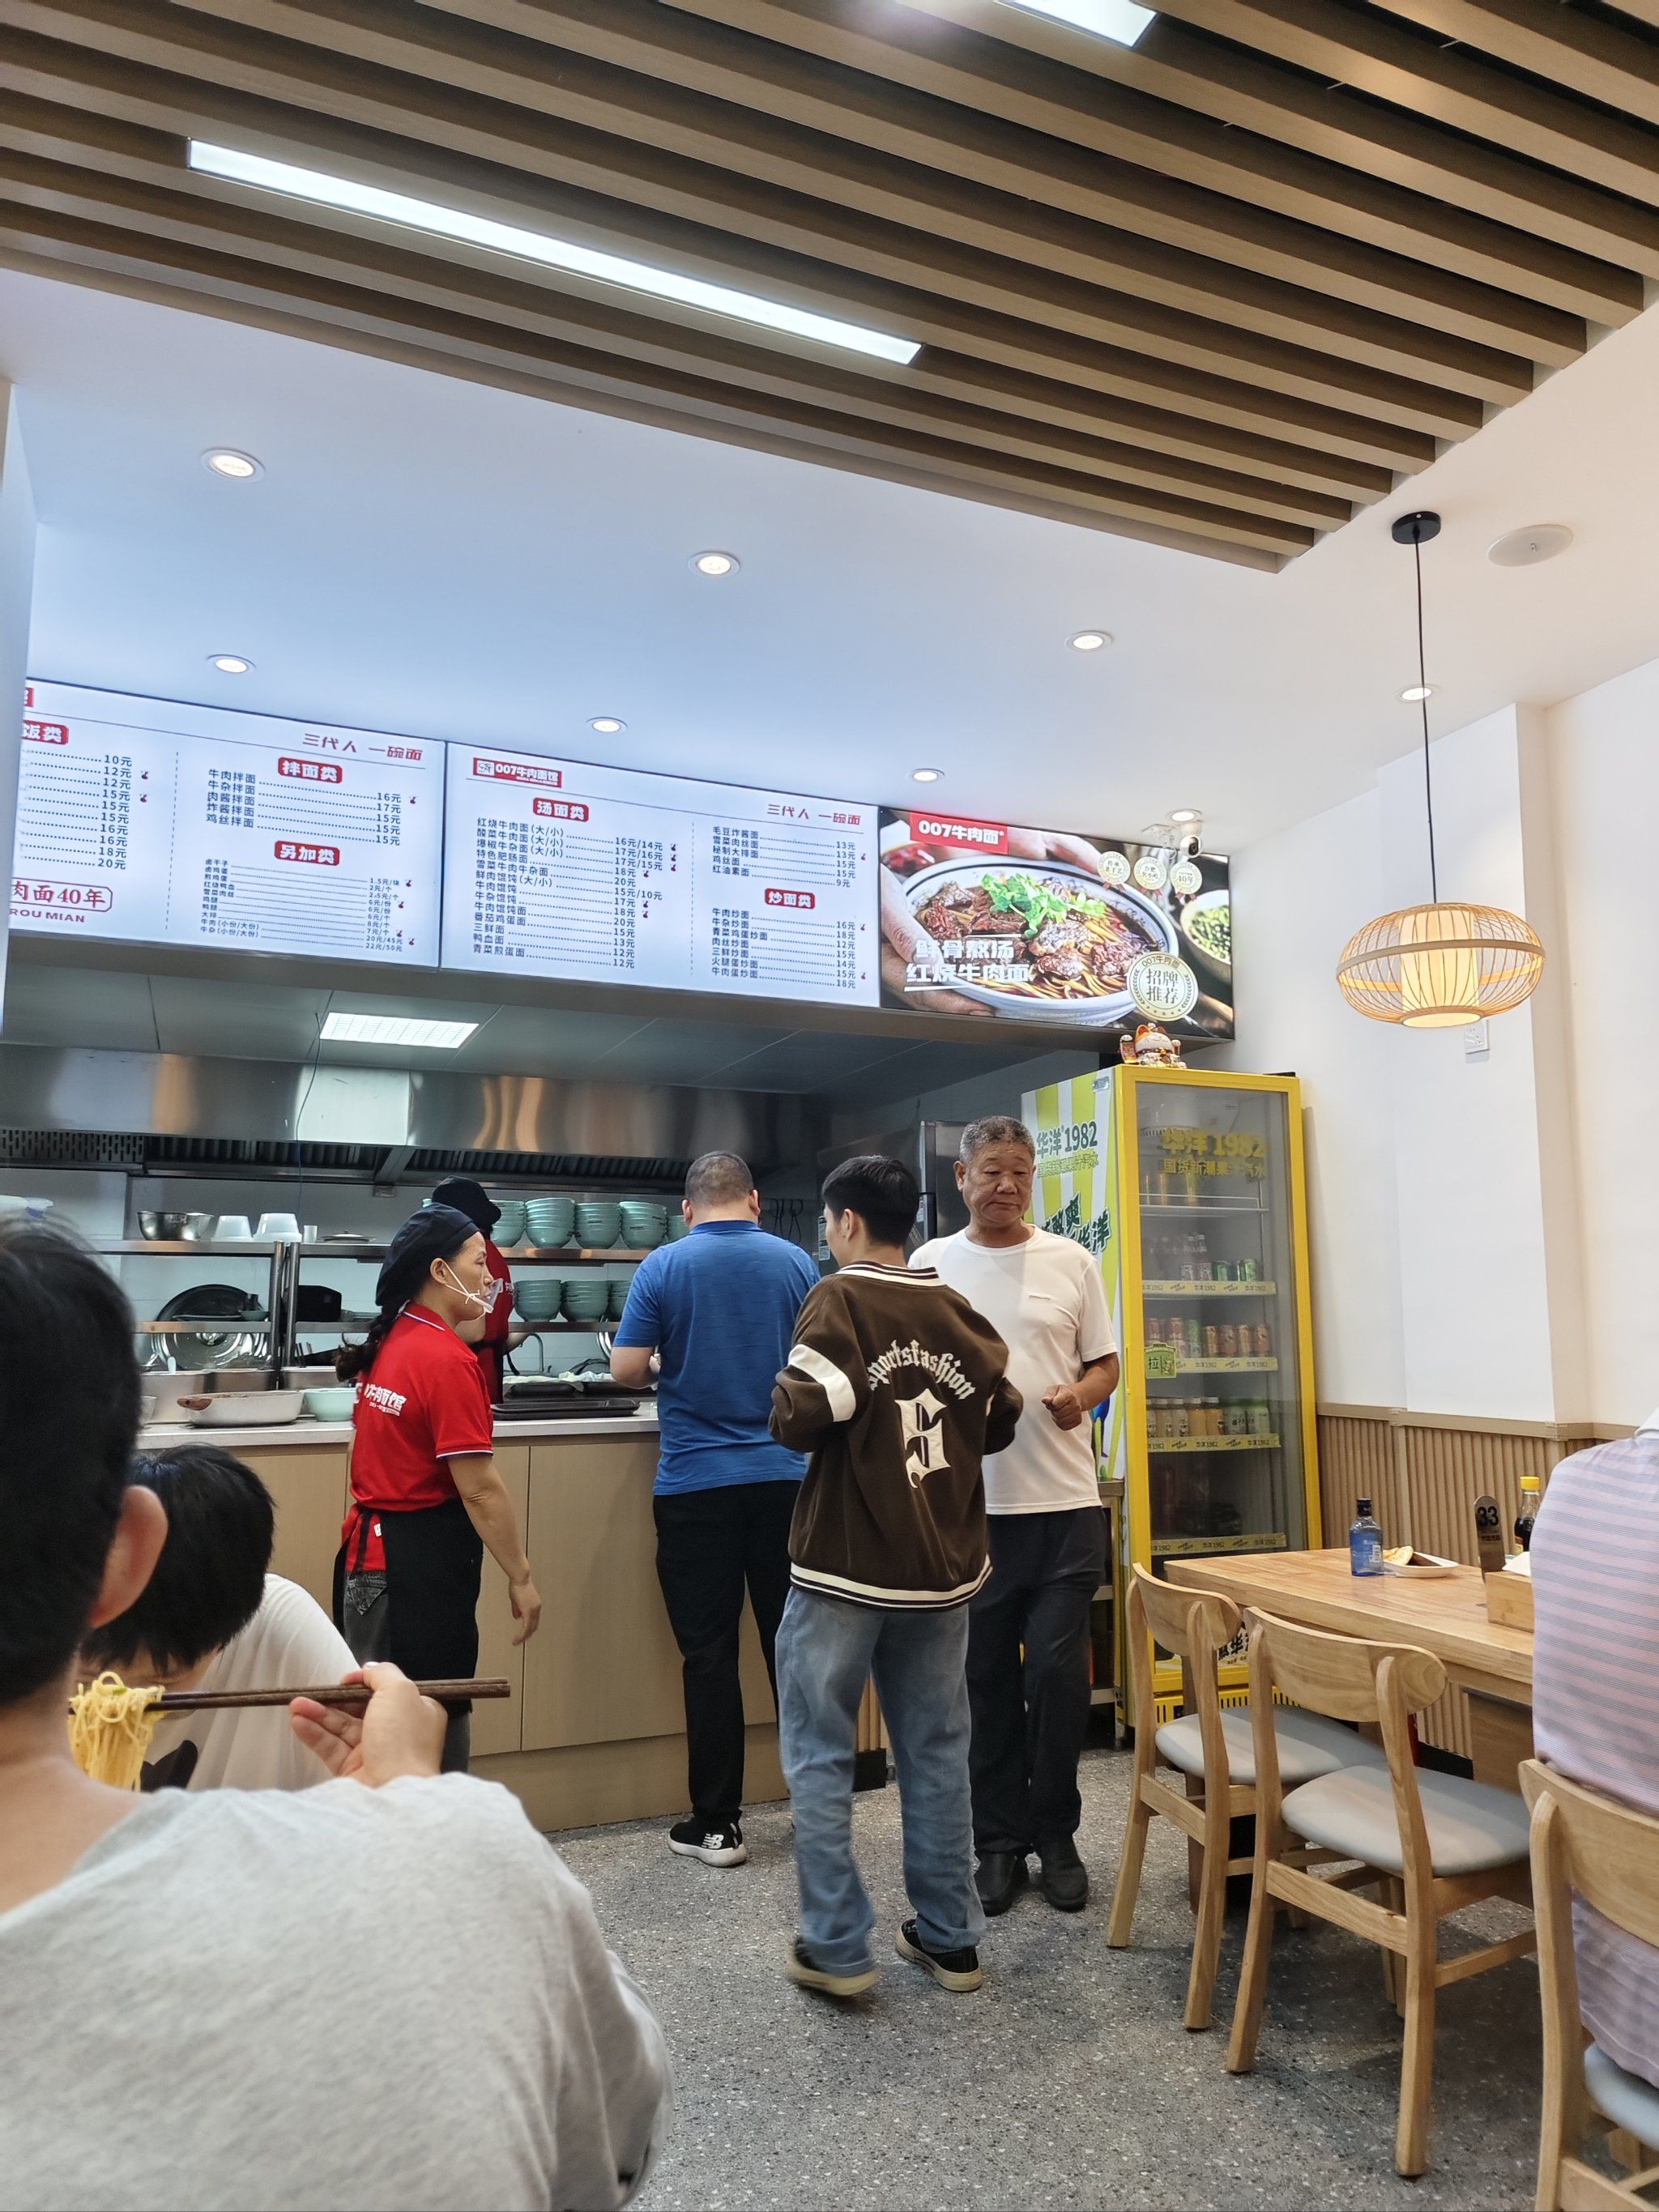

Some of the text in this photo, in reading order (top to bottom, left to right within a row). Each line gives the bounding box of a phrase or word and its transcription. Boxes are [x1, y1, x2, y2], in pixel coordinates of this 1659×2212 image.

[302, 733, 423, 761] 三代人 一碗面
[104, 755, 132, 767] 10元
[104, 766, 131, 778] 12元
[282, 761, 338, 782] 拌面类
[103, 778, 130, 790] 12元
[209, 769, 401, 803] 牛肉拌面 16元
[102, 789, 130, 801] 15元
[208, 780, 401, 813] 牛杂拌面 17元
[101, 801, 130, 812] 15元
[101, 812, 129, 824] 15元
[207, 803, 400, 835] 炸酱拌面 15元
[377, 814, 400, 824] 15元
[767, 803, 861, 825] 三代人 一碗面
[100, 824, 128, 835] 16元
[206, 813, 399, 846] 鸡丝拌面 15元
[918, 820, 999, 845] 007牛肉面
[100, 836, 127, 847] 16元
[616, 837, 663, 850] 16元/14元
[837, 842, 855, 850] 13元
[99, 847, 126, 859] 18元
[279, 844, 335, 864] 另加类
[616, 847, 663, 861] 17元/16元
[837, 850, 855, 859] 13元
[97, 859, 126, 870] 20元
[616, 858, 663, 871] 17元/15元
[837, 860, 855, 869] 15元
[615, 867, 636, 878] 18元
[837, 870, 855, 879] 15元
[615, 877, 636, 887] 20元
[837, 879, 850, 888] 9元
[615, 888, 662, 901] 15元/10元
[615, 897, 635, 907] 17元
[45, 912, 85, 923] MIAN
[614, 908, 635, 918] 18元
[614, 918, 635, 927] 20元
[837, 921, 855, 930] 16元
[614, 928, 635, 938] 15元
[837, 931, 855, 940] 18元
[613, 938, 634, 948] 13元
[837, 940, 855, 949] 12元
[613, 948, 634, 958] 12元
[837, 950, 855, 959] 15元
[915, 940, 1014, 959] 鲜骨熬汤
[613, 959, 634, 969] 12元
[837, 960, 855, 969] 14元
[837, 970, 855, 978] 15元
[906, 963, 1030, 982] 红烧牛肉面
[1146, 969, 1178, 987] 招牌
[837, 979, 855, 989] 18元
[1146, 986, 1178, 1004] 推荐
[1148, 1357, 1159, 1370] 拉
[1478, 1506, 1499, 1526] 33
